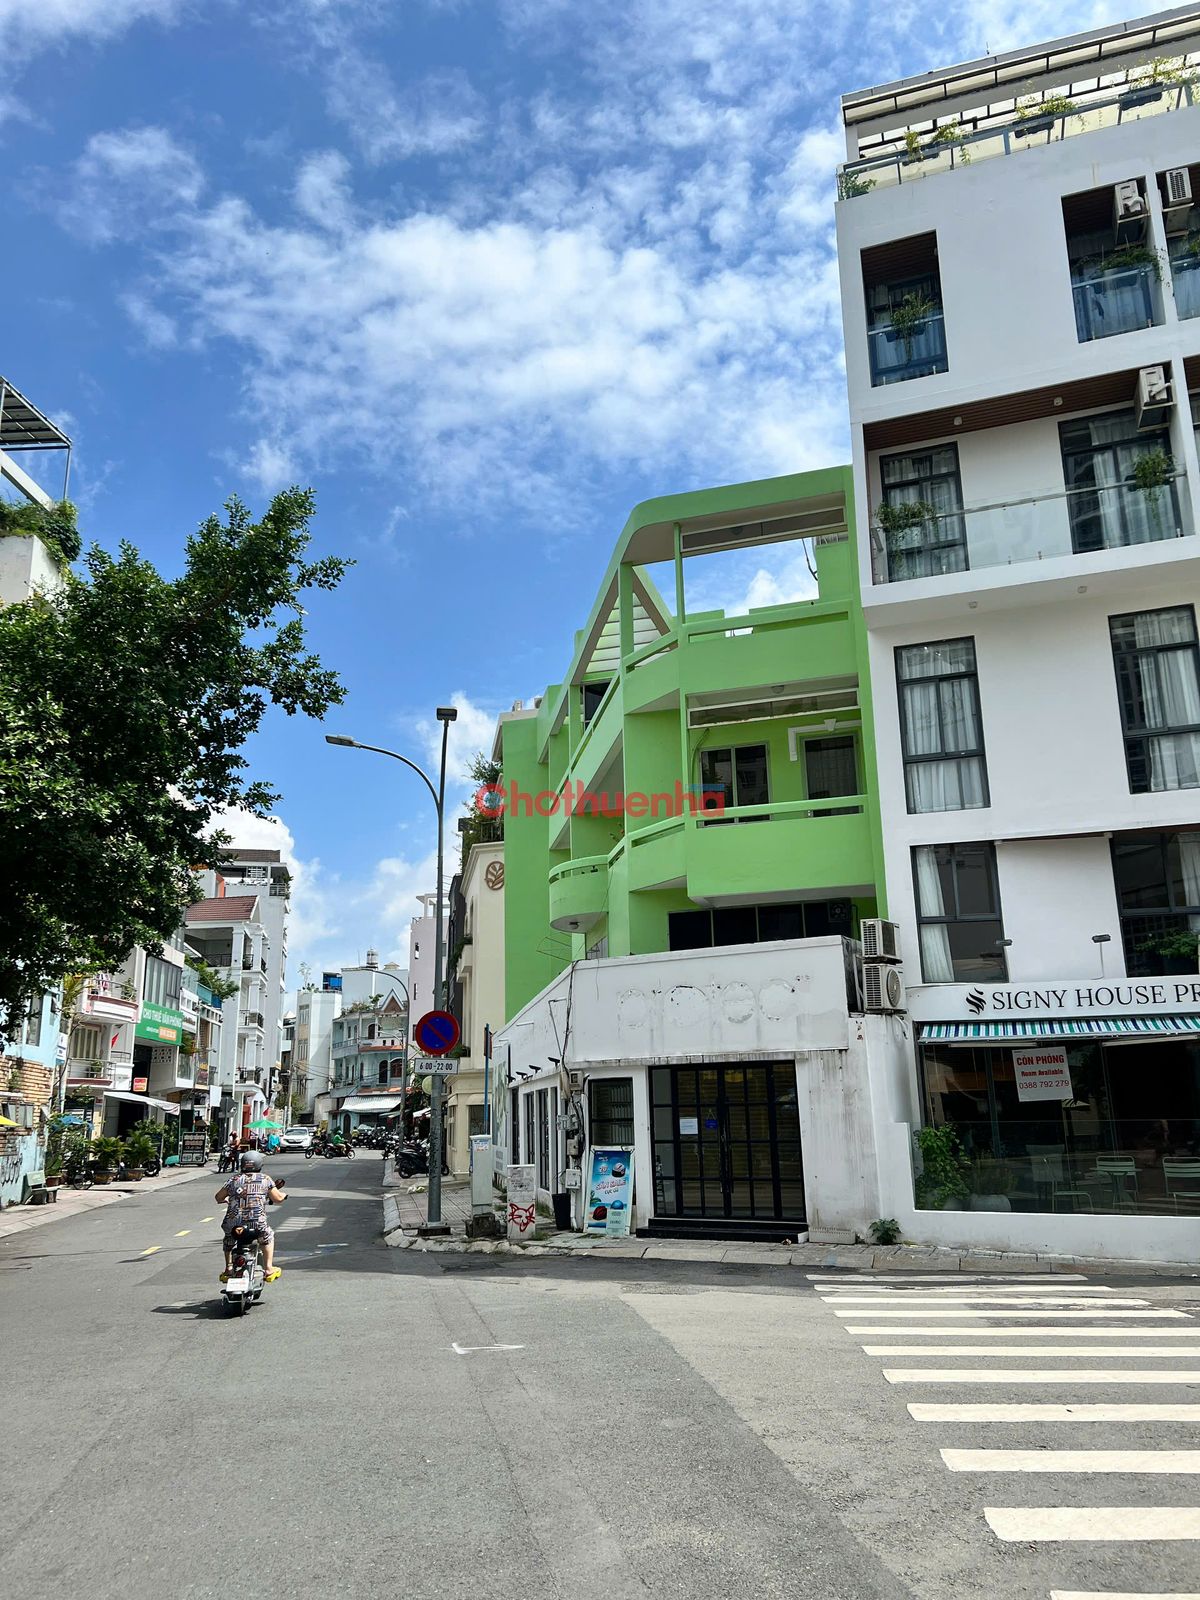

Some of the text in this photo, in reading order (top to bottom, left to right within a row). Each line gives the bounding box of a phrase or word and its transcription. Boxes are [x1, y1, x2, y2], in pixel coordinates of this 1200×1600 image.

[992, 989, 1068, 1010] SIGNY
[1075, 985, 1167, 1007] HOUSE
[1016, 1053, 1065, 1066] CÒN PHÒNG
[1019, 1079, 1070, 1090] 0388 792 279
